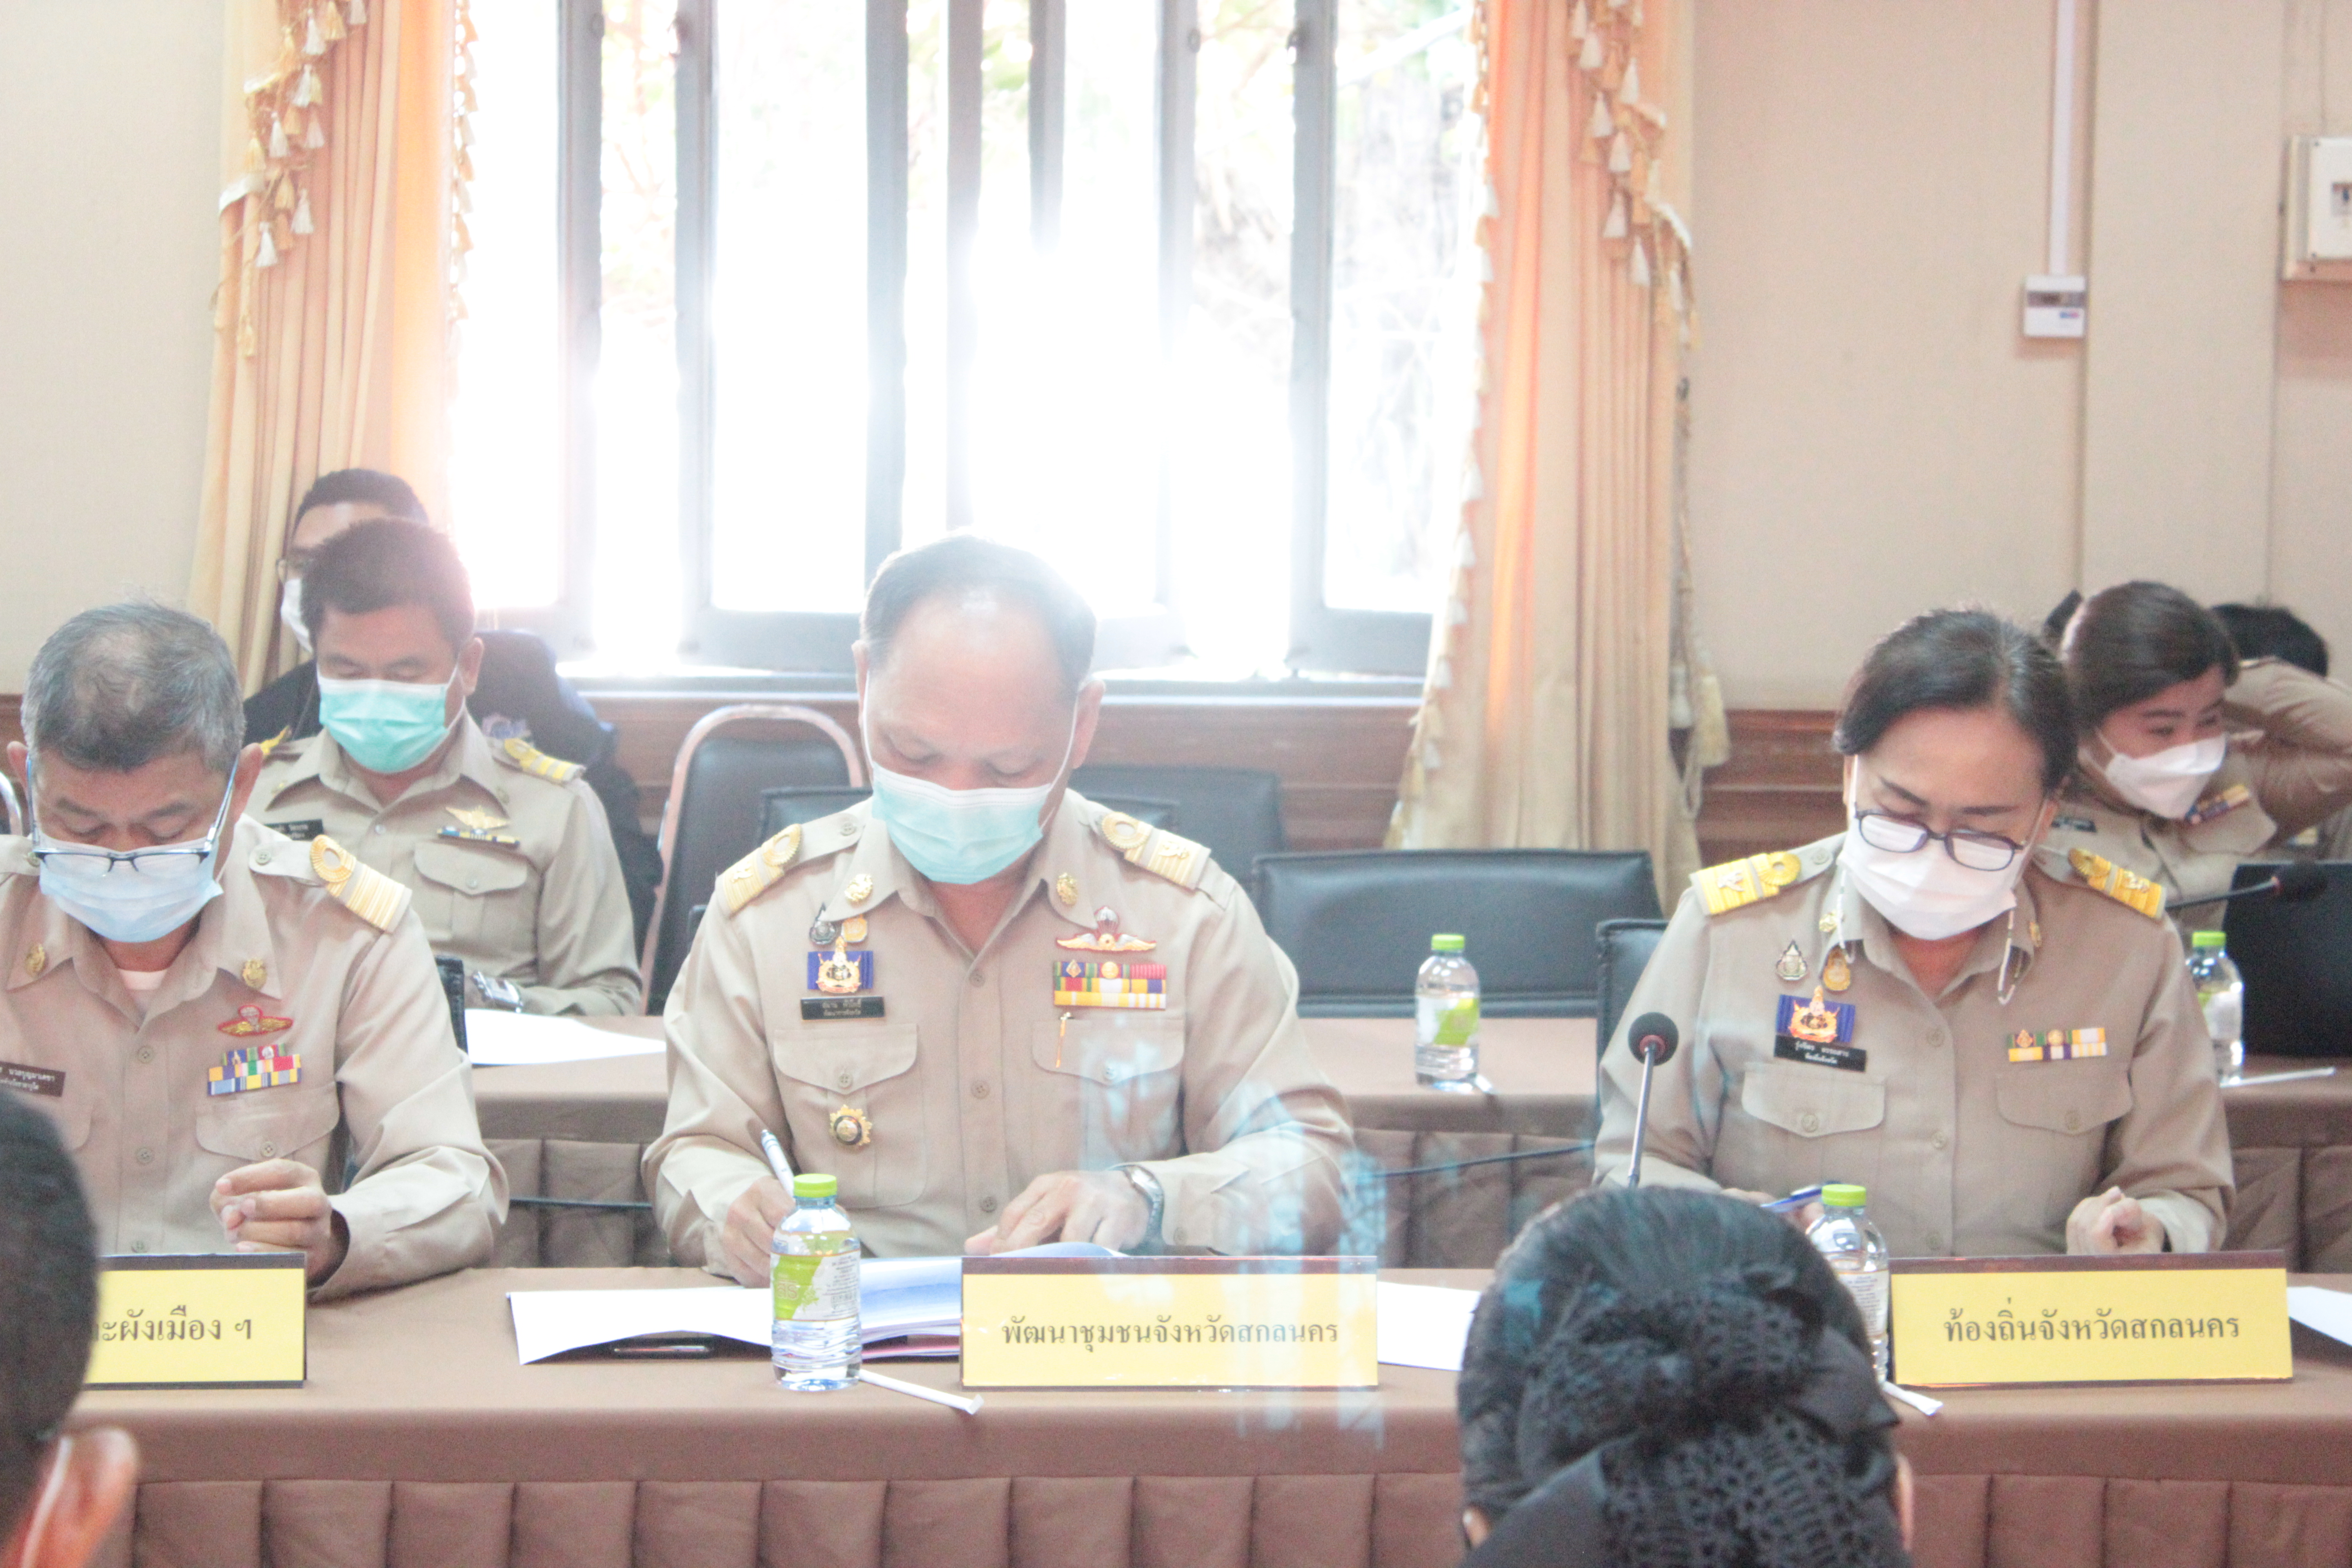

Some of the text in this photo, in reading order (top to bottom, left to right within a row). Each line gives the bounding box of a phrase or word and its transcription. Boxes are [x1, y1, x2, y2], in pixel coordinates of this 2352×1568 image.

[93, 1305, 221, 1342] ะผังเมือง
[1002, 1315, 1339, 1353] พัฒนาชุมชนจังหวัดสกลนคร
[1944, 1297, 2240, 1342] ท้องถิ่นจังหวัดสกลนคร
